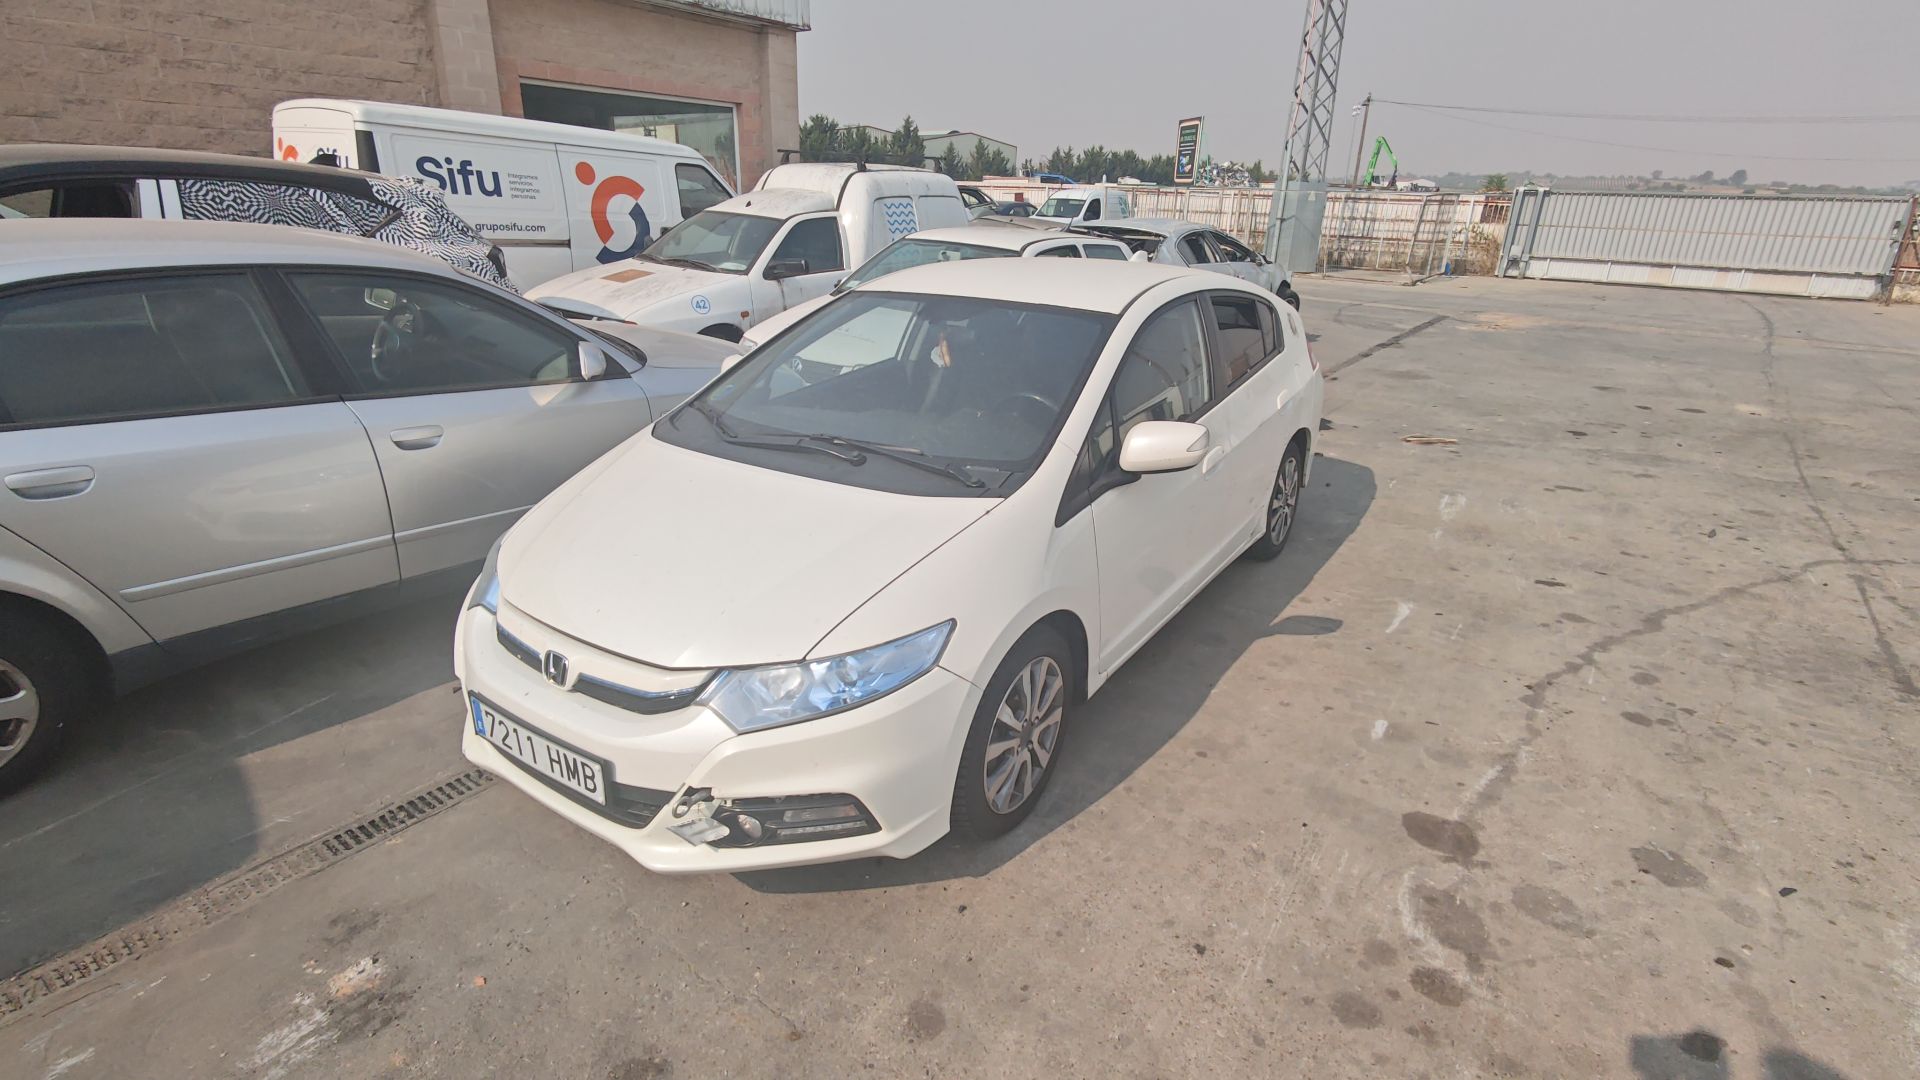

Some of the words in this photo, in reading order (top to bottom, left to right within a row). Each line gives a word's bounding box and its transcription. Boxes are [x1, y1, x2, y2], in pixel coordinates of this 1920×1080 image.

[416, 156, 503, 197] Sifu
[475, 222, 546, 233] gruposifu.com
[695, 299, 708, 310] 42
[484, 710, 537, 765] 7211
[546, 745, 597, 794] HMB
